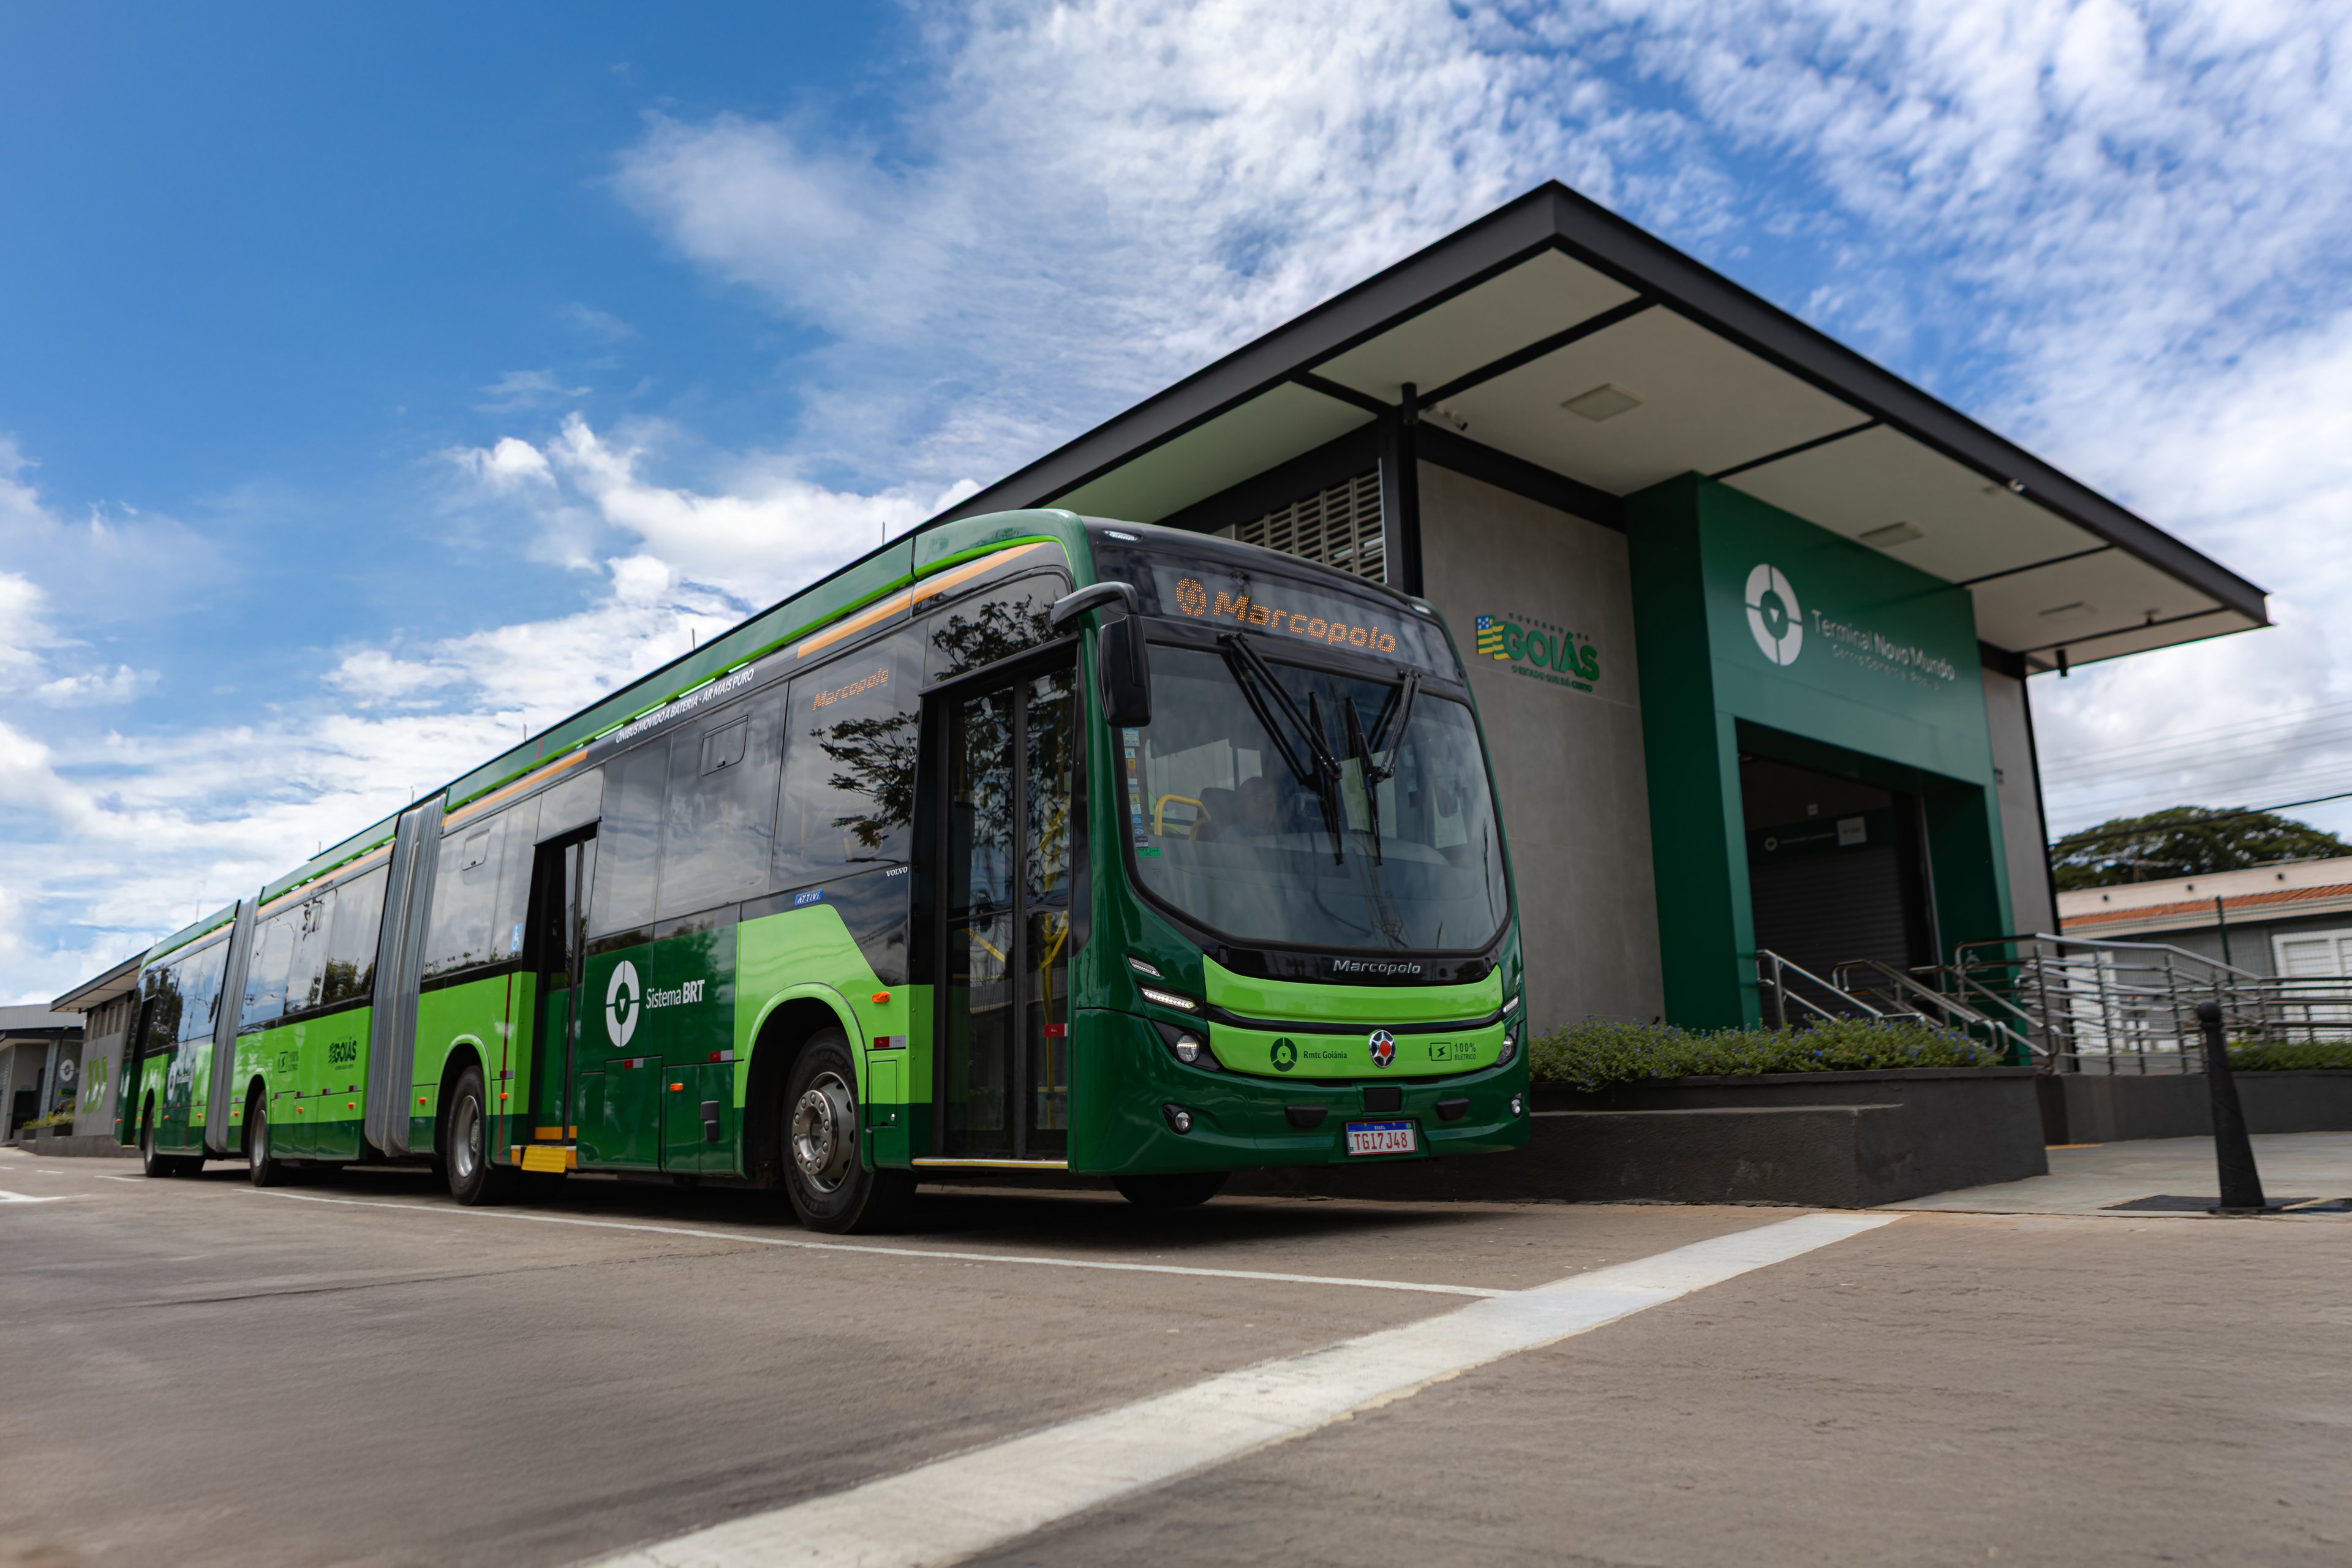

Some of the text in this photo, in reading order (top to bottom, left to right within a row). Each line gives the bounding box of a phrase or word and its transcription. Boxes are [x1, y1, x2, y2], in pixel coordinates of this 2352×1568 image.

[1213, 590, 1396, 653] Marcopolo
[1509, 612, 1564, 635] GOVERNO
[1502, 623, 1600, 681] GOIÁS
[1812, 609, 1956, 681] Terminal Novo Mundo
[638, 710, 664, 732] MOVIDO
[663, 707, 670, 721] A
[670, 695, 698, 718] BATERIA
[702, 690, 714, 704] AR
[713, 679, 731, 698] MAIS
[732, 668, 755, 689] PURO
[812, 668, 889, 710] Marcopolo
[886, 866, 908, 877] VOLVO
[1333, 960, 1421, 976] Marcopolo
[646, 979, 706, 1009] Sistema BRT
[1303, 1050, 1348, 1059] Rmtc Goiânia
[1454, 1042, 1476, 1052] 100%
[1354, 1131, 1408, 1150] TGI7J48
